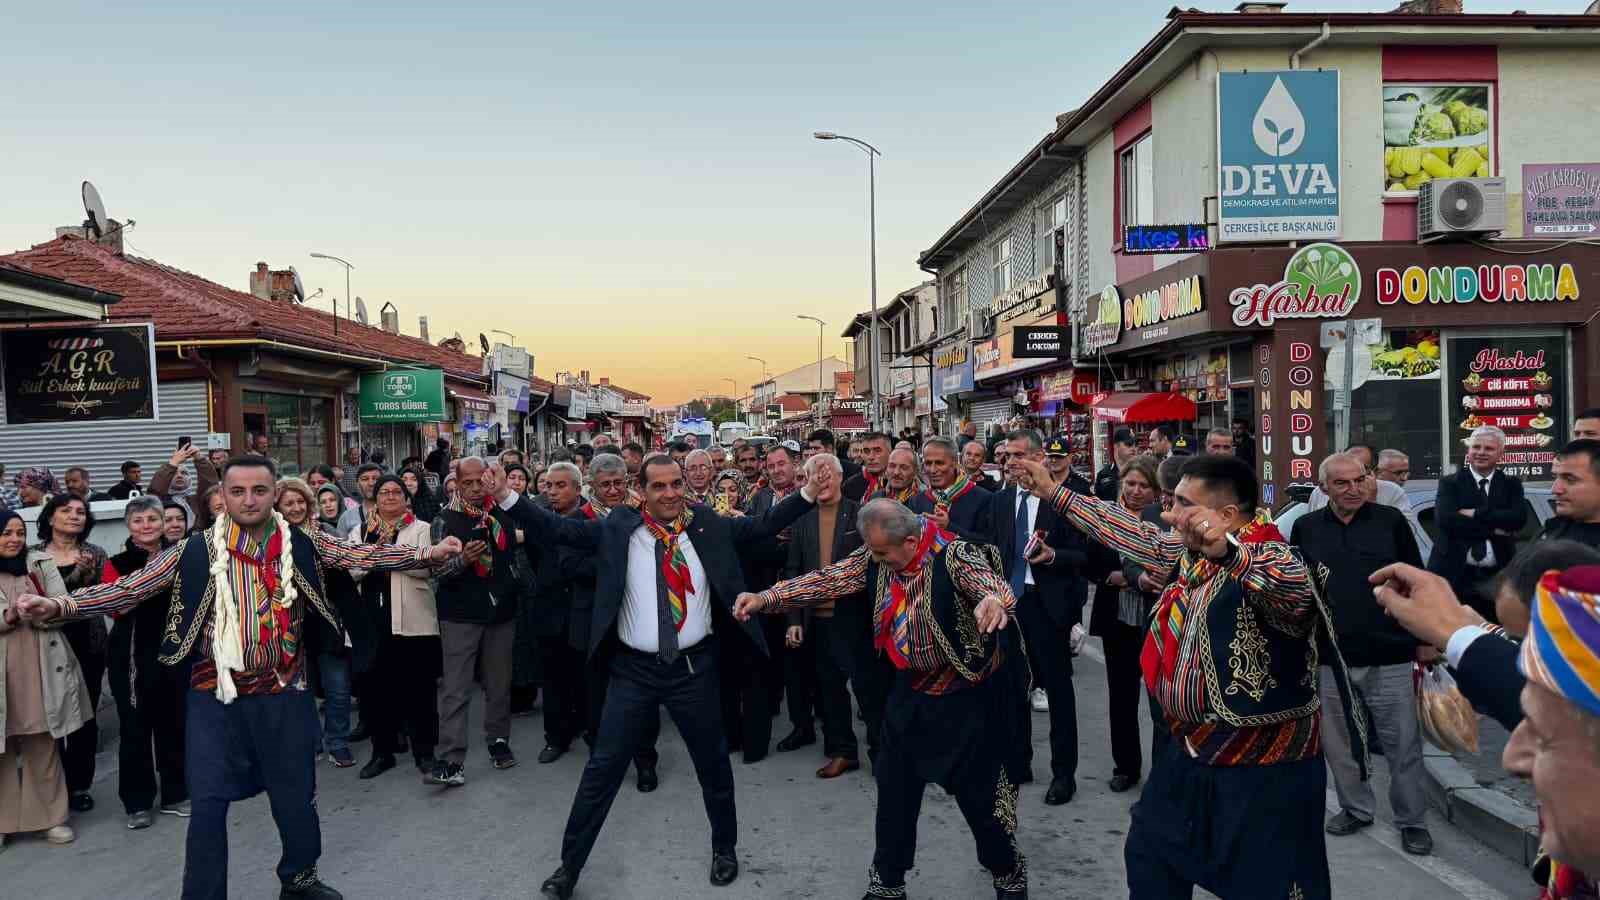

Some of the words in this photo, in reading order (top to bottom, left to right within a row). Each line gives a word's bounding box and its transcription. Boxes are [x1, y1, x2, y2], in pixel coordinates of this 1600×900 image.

[1222, 163, 1337, 196] DEVA
[1376, 263, 1580, 305] DONDURMA
[1124, 275, 1202, 331] DONDURMA
[1231, 281, 1352, 326] Hasbal
[1470, 349, 1546, 372] Hasbal
[1503, 378, 1529, 390] KÖFTE
[374, 401, 400, 410] TOROS
[1288, 342, 1314, 487] DONDUR
[1483, 398, 1531, 408] DONDURMA
[1496, 417, 1519, 427] TATLI
[1504, 433, 1536, 445] URABİYESİ
